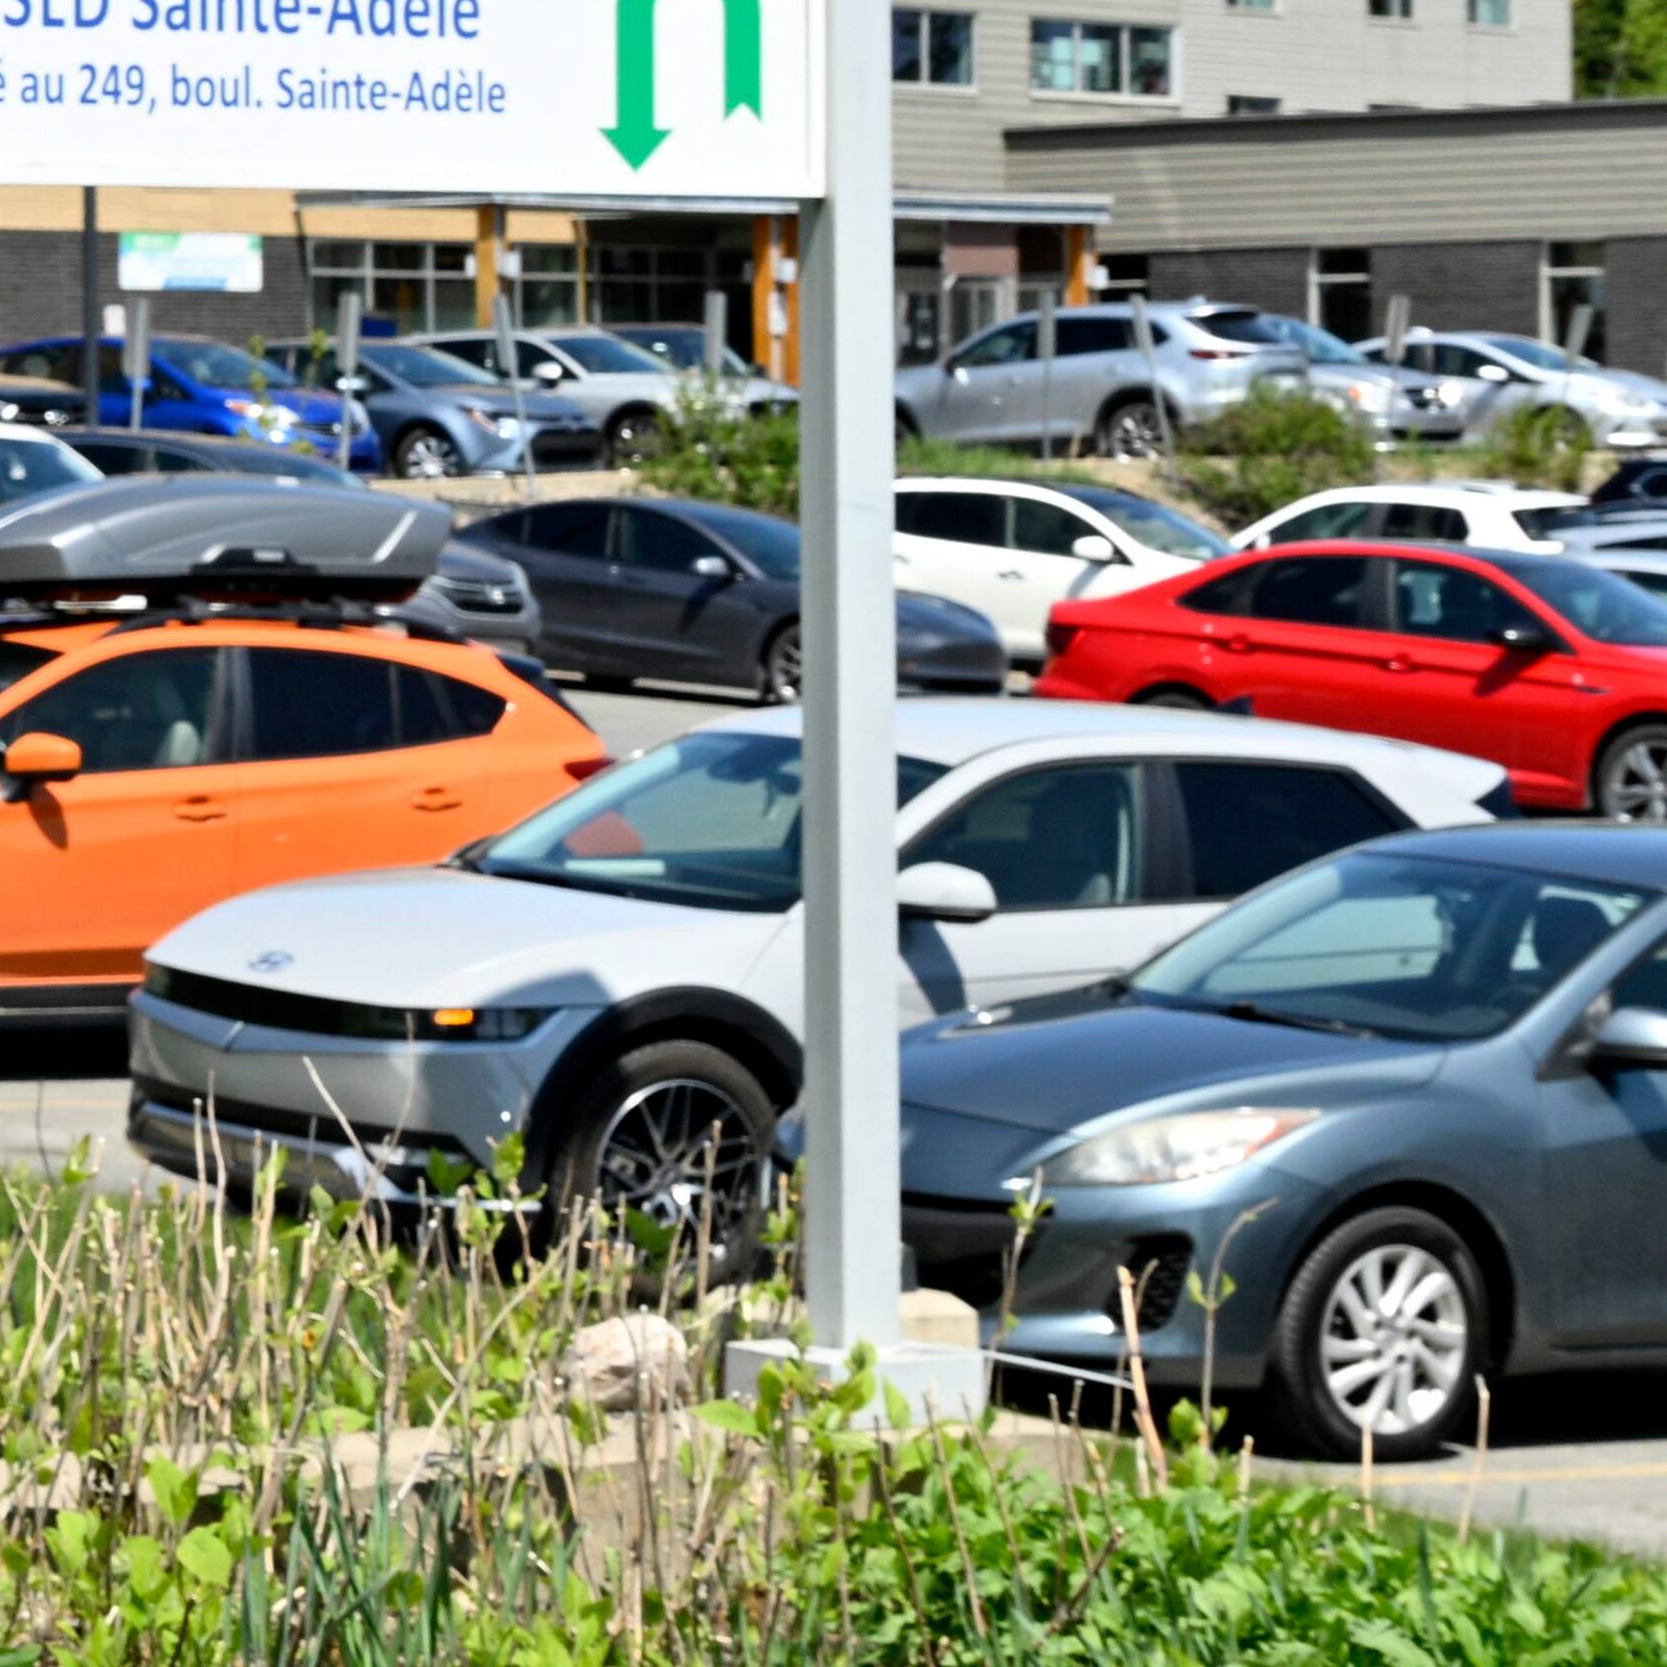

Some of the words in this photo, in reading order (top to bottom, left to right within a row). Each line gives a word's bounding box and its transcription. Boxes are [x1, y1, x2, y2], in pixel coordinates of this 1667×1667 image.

[21, 72, 63, 104] au
[79, 63, 158, 115] 249,
[172, 64, 264, 108] boul.
[277, 68, 505, 113] Sainte-Adèle
